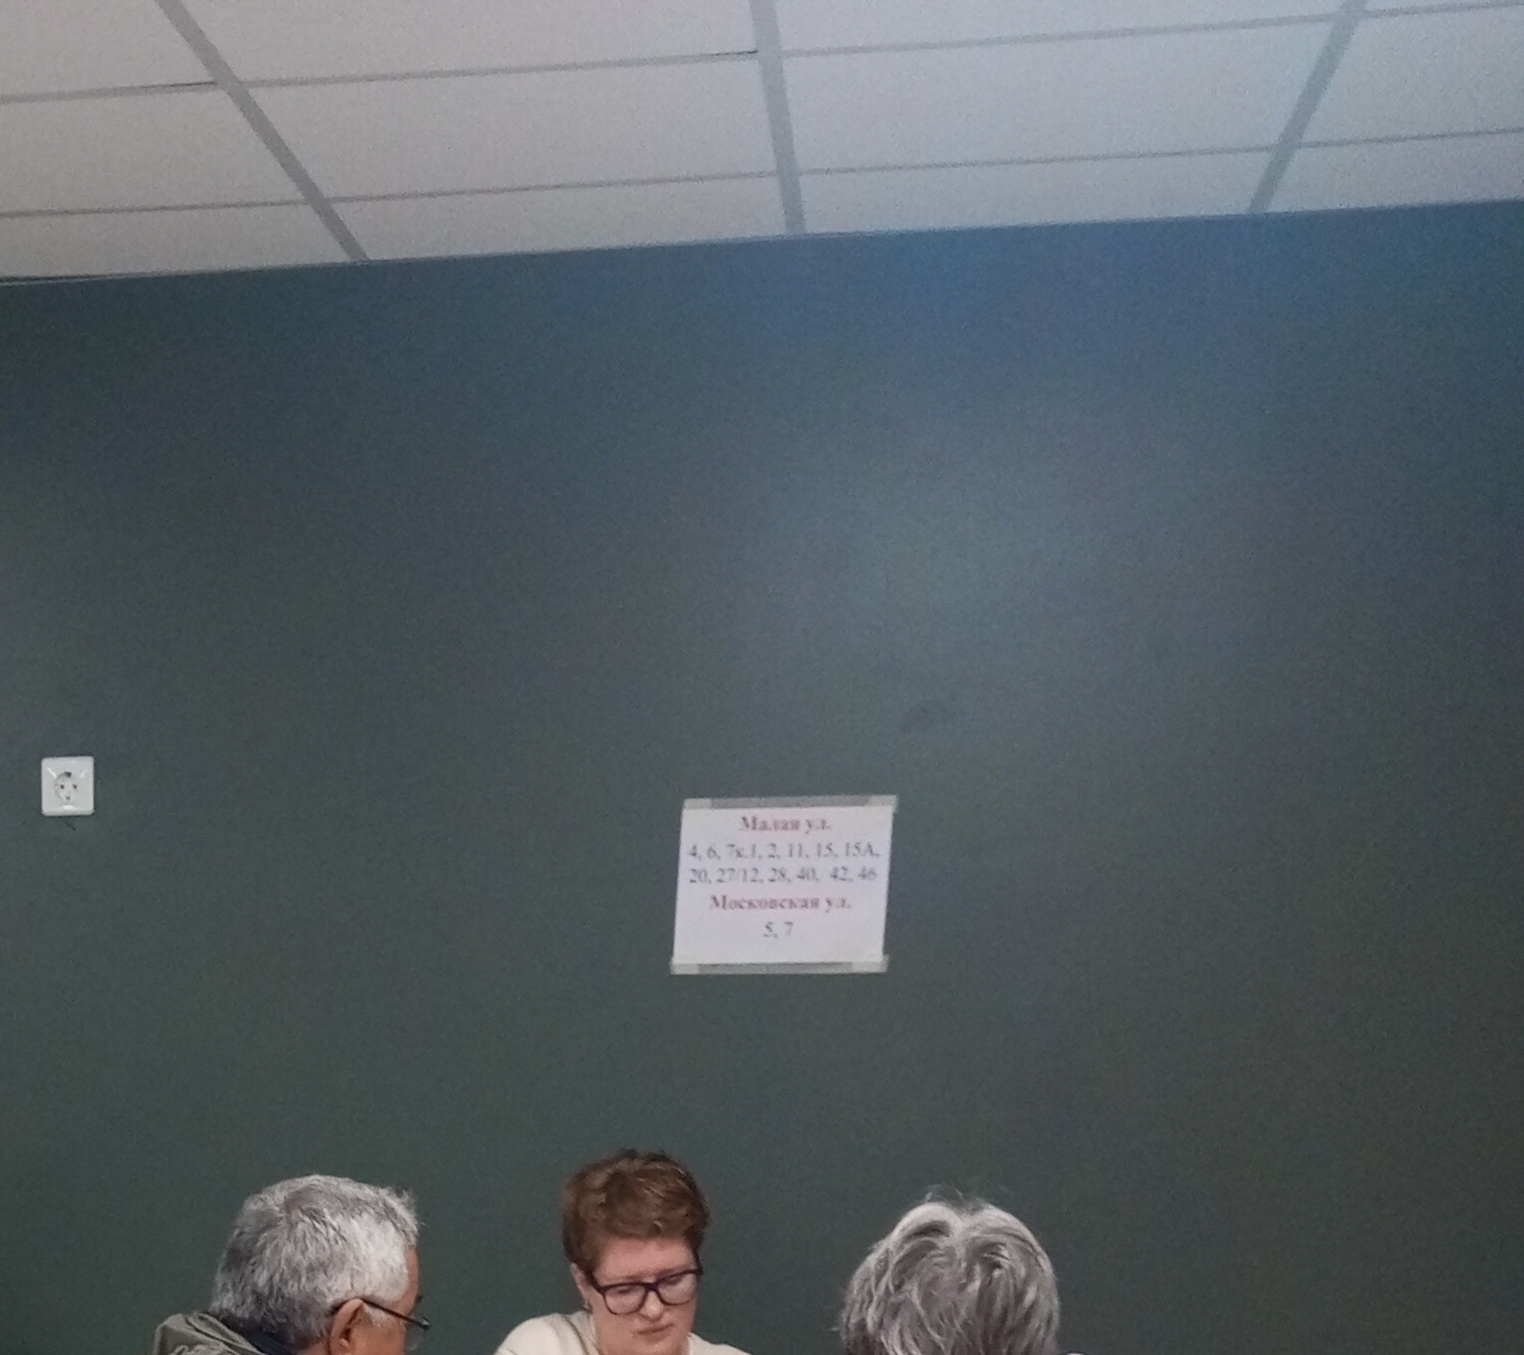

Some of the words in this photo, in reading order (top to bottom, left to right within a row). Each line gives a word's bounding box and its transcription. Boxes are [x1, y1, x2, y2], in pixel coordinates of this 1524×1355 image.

[740, 816, 800, 832] Малая
[805, 819, 832, 835] ул.
[709, 895, 820, 911] Московская
[825, 896, 852, 913] ул.
[783, 921, 794, 937] 7
